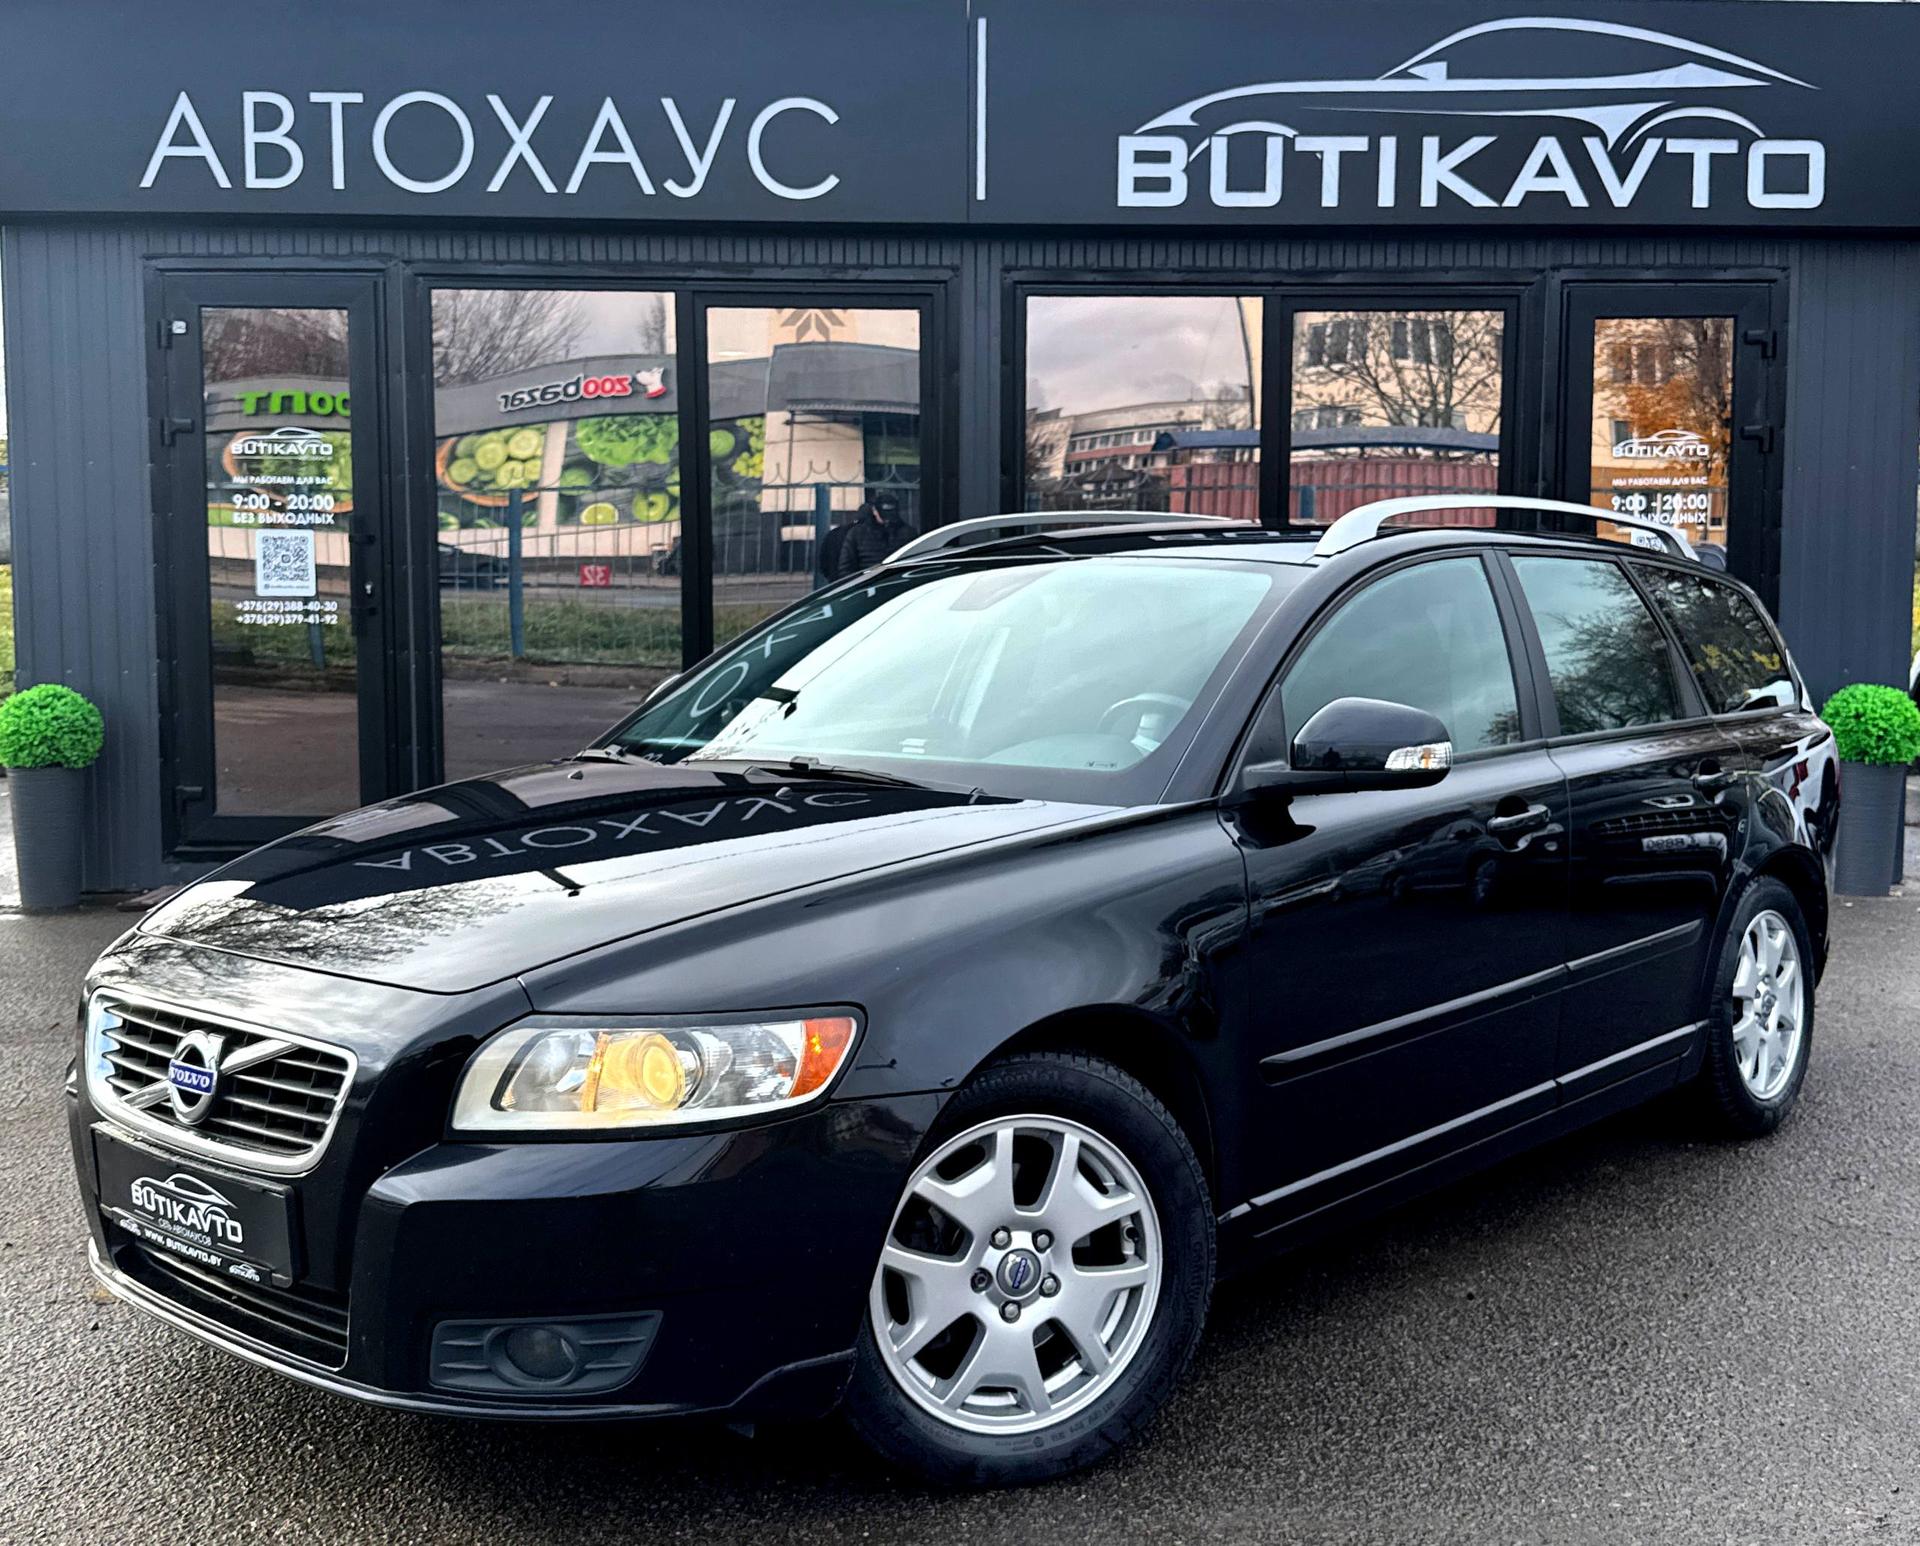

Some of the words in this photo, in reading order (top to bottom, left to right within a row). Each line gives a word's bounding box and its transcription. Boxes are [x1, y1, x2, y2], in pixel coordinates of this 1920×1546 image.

[139, 90, 840, 199] АВТОХАУС
[1116, 134, 1826, 208] BUTIKAVTO
[231, 441, 334, 455] BUTIKAVTO
[1613, 445, 1709, 457] BUTIKAVTO
[249, 476, 295, 485] РАБОТАЕМ
[314, 476, 333, 485] ВАС
[1628, 477, 1671, 486] РАБОТАЕМ
[1672, 477, 1689, 486] ДЛЯ
[1690, 476, 1708, 485] ВАС
[232, 493, 270, 510] 9:00
[286, 493, 335, 510] 20:00
[1611, 495, 1647, 511] 9:00
[1662, 493, 1707, 510] 20:00
[232, 512, 255, 524] БЕЗ
[258, 512, 335, 525] ВЫХОДНЫХ
[170, 1066, 210, 1088] VOLVO
[131, 1184, 244, 1243] BUTIKAVTO
